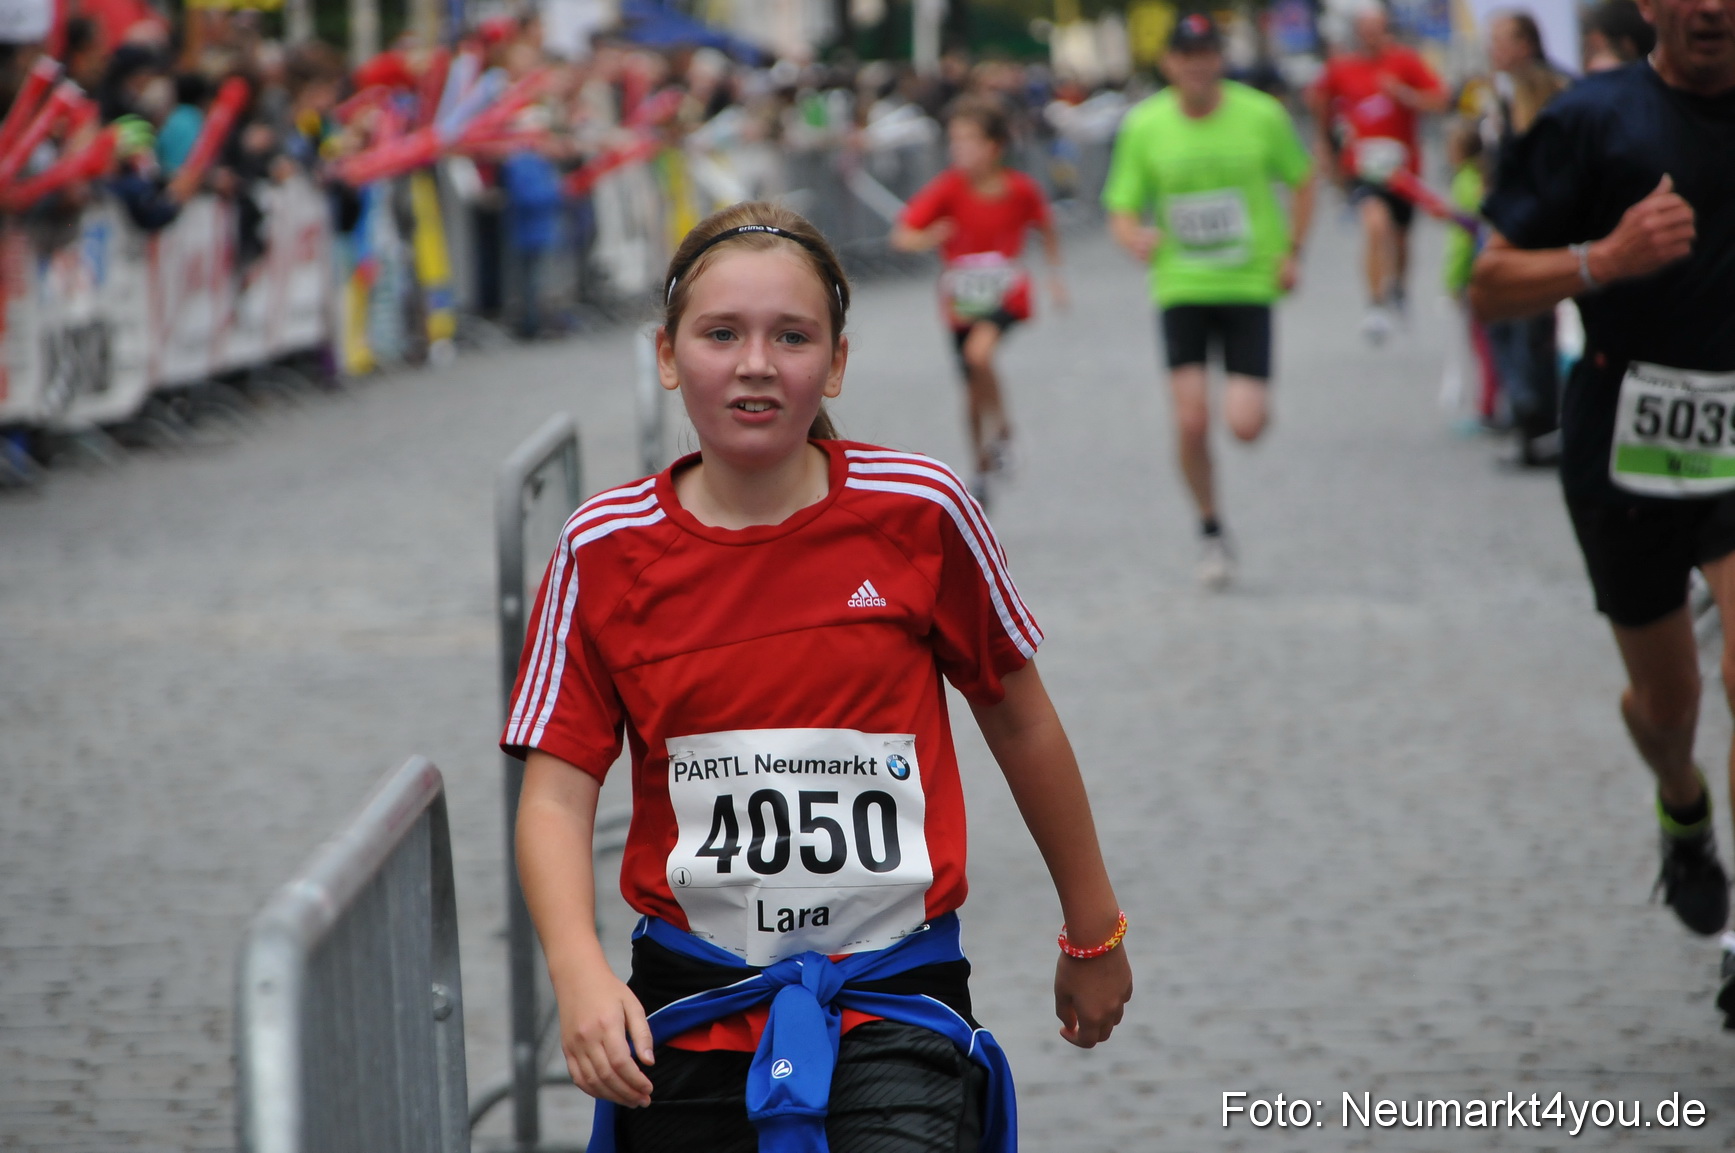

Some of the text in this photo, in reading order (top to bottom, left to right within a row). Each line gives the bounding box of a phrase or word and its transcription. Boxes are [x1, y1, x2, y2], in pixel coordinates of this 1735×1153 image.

[1634, 396, 1735, 446] 503
[847, 596, 887, 607] adidas
[674, 753, 878, 782] PARTL Neumarkt
[694, 788, 902, 875] 4050
[756, 899, 829, 933] Lara
